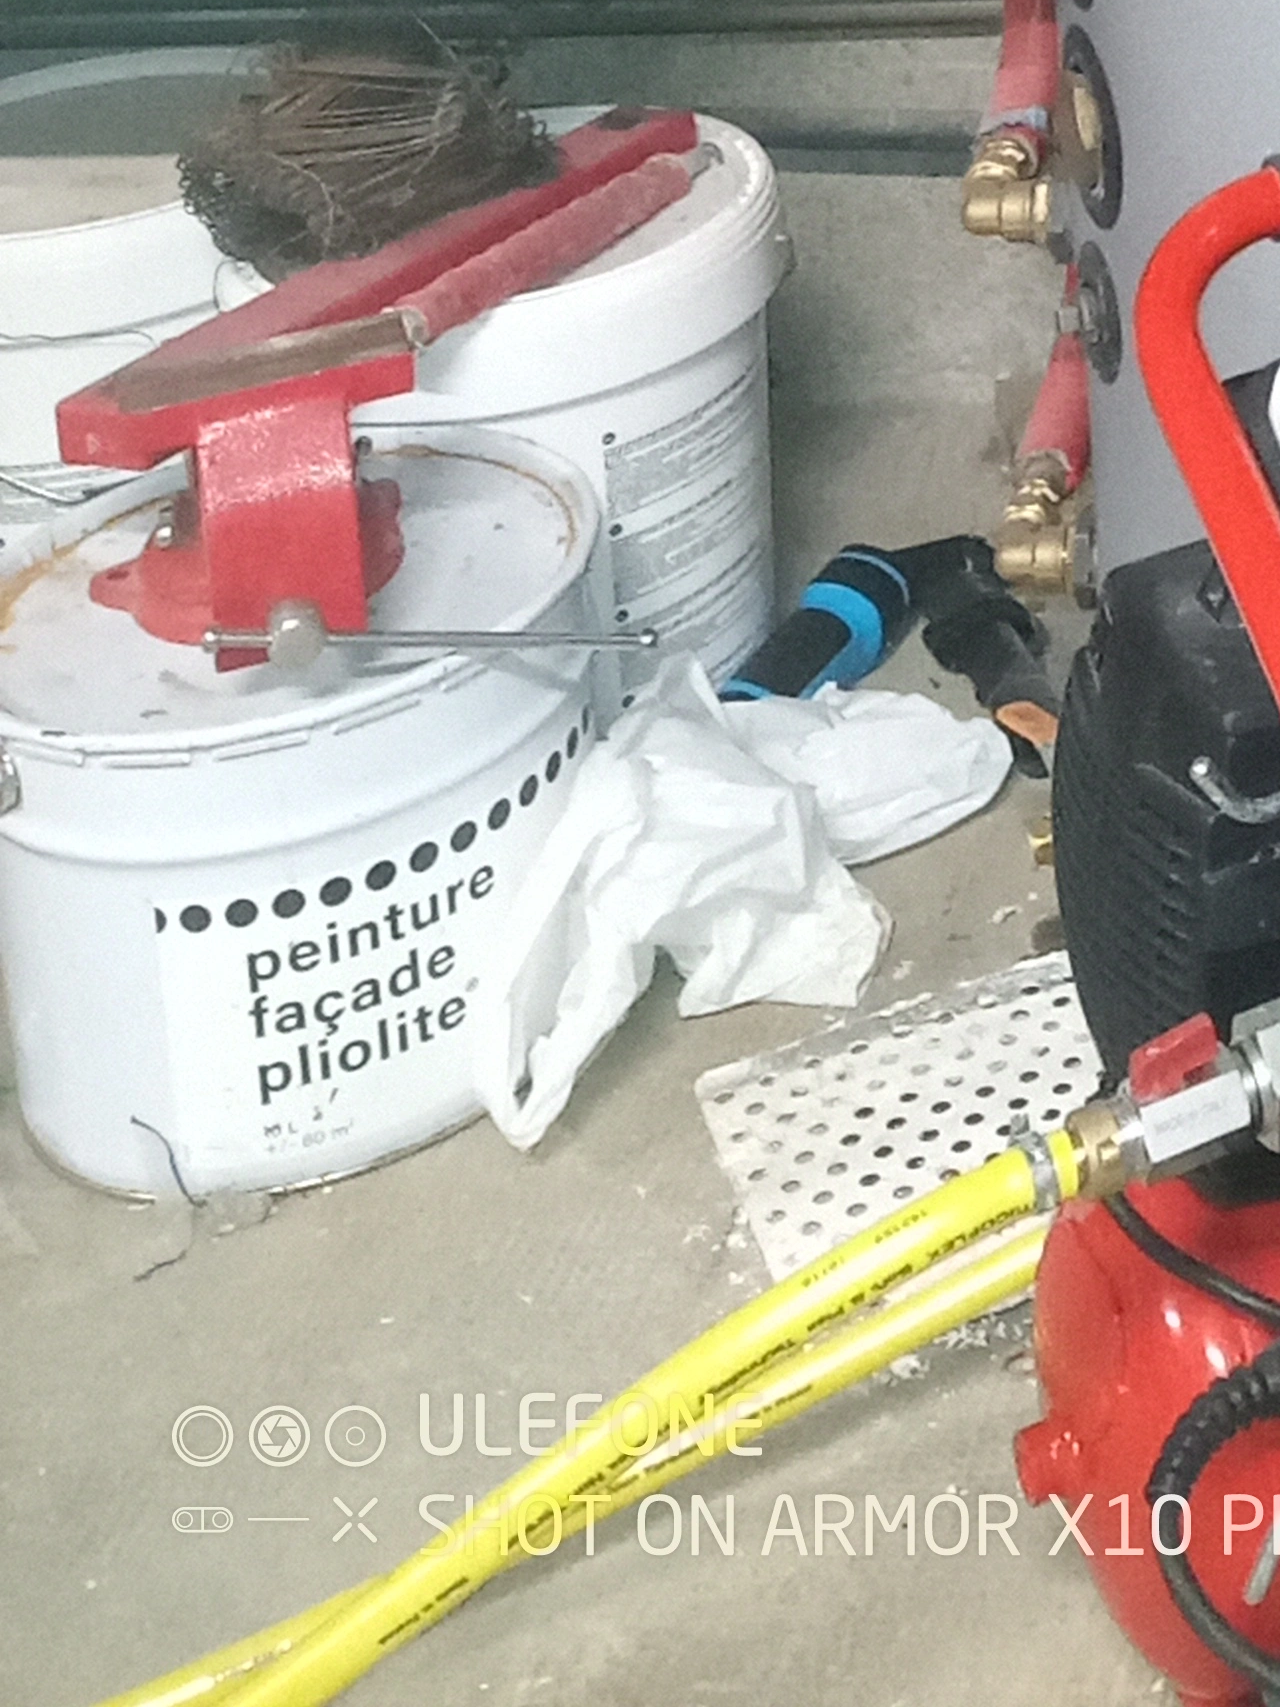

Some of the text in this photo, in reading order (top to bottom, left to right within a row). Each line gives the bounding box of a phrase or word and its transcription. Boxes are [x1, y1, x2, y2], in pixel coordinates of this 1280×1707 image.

[246, 863, 496, 994] peinture
[248, 943, 456, 1039] façade
[256, 995, 468, 1106] pliolite
